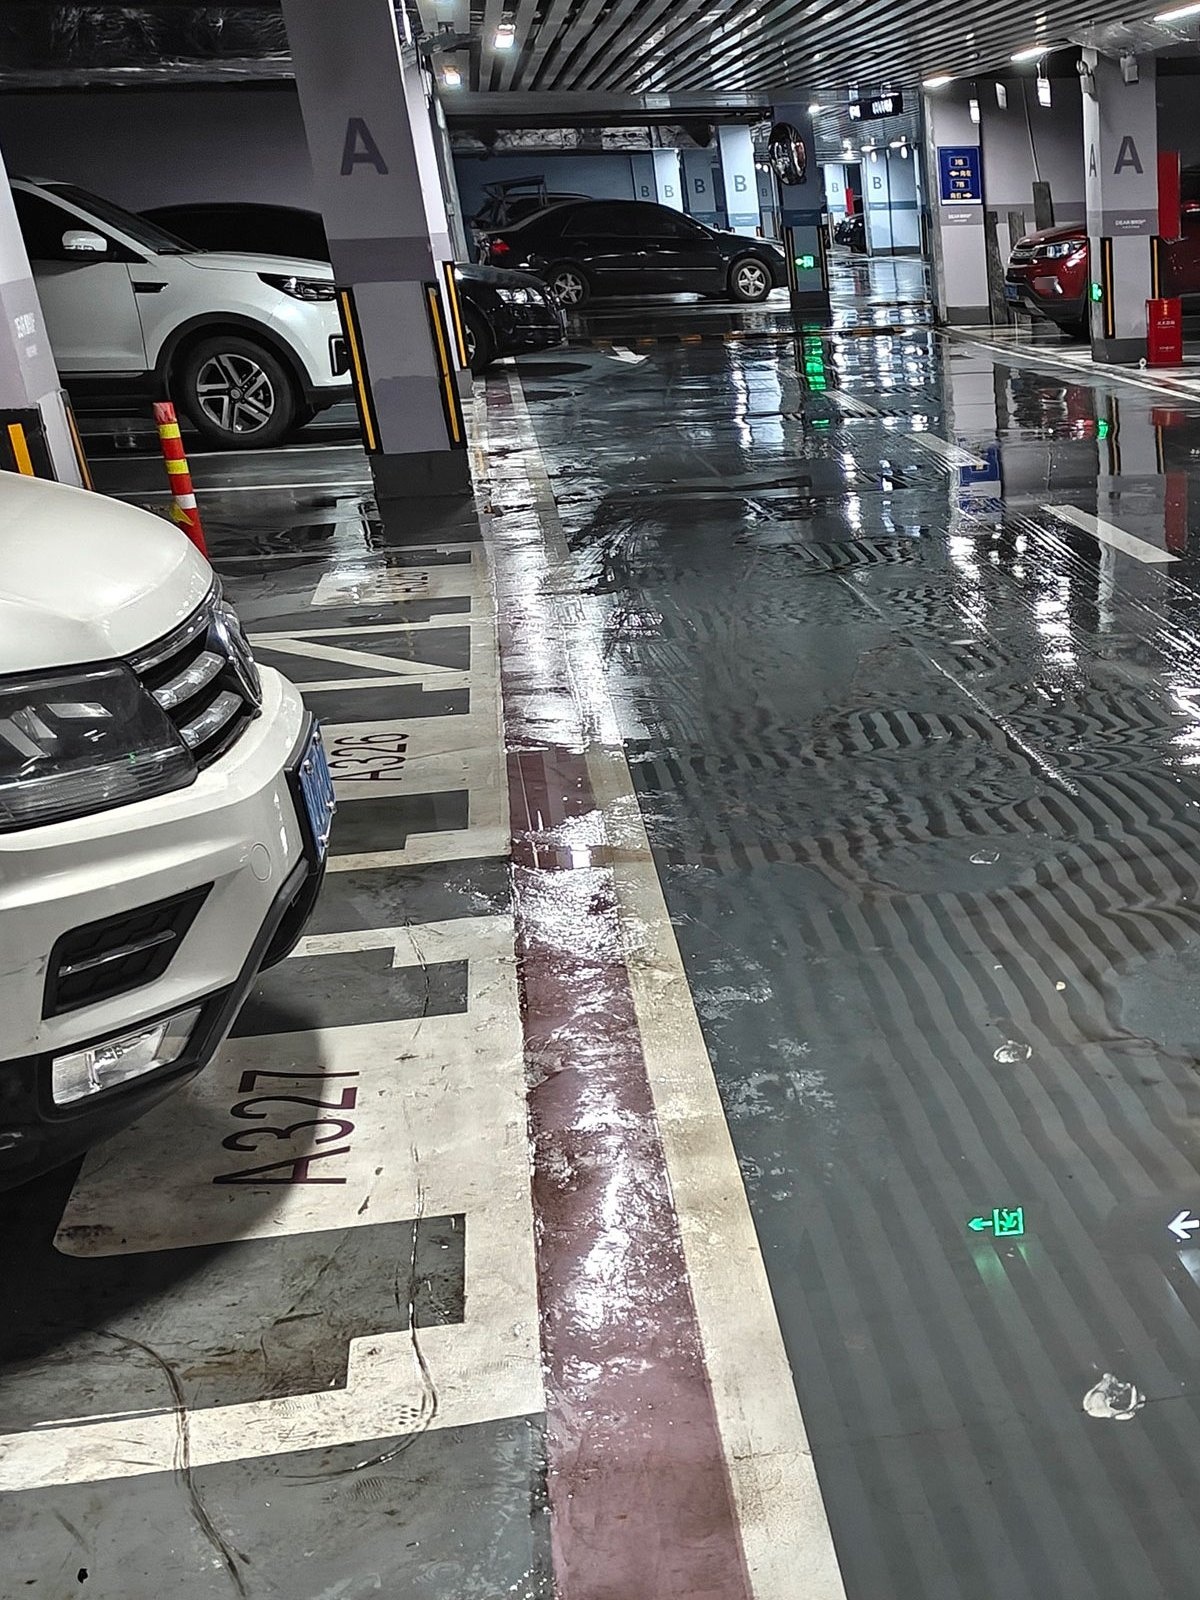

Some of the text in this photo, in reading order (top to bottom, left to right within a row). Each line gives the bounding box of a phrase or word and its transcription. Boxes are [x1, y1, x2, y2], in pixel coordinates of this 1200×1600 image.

[340, 117, 389, 176] A
[1113, 135, 1144, 174] A
[1089, 143, 1098, 177] A
[641, 185, 650, 197] B
[694, 179, 706, 194] B
[734, 175, 748, 192] B
[832, 183, 839, 193] B
[873, 177, 882, 189] B
[664, 185, 674, 198] B
[762, 188, 768, 197] B
[327, 733, 410, 781] A326
[212, 1070, 360, 1185] A327
